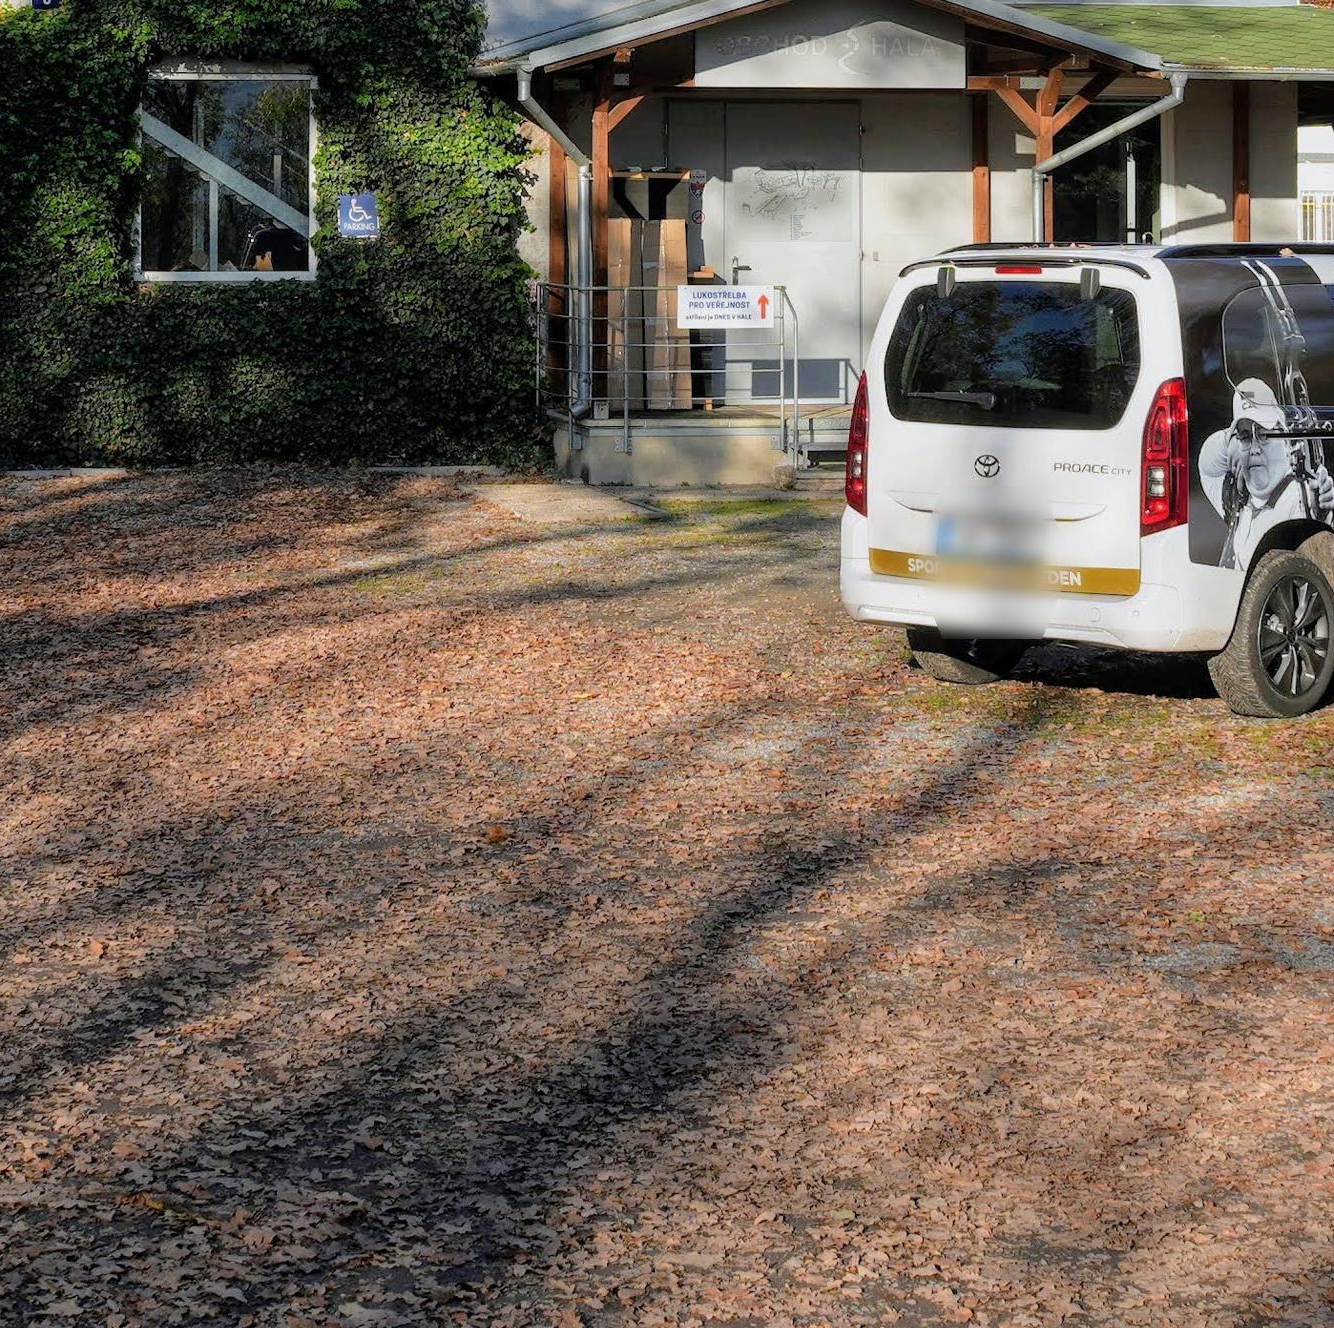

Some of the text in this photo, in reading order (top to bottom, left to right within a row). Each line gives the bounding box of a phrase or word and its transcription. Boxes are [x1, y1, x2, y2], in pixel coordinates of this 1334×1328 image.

[872, 36, 938, 57] HALA
[343, 222, 375, 231] PARKING
[692, 290, 747, 299] LUKOSTŘELBA
[688, 299, 751, 309] PRO VEŘEJNOST
[1053, 462, 1109, 475] PROACE
